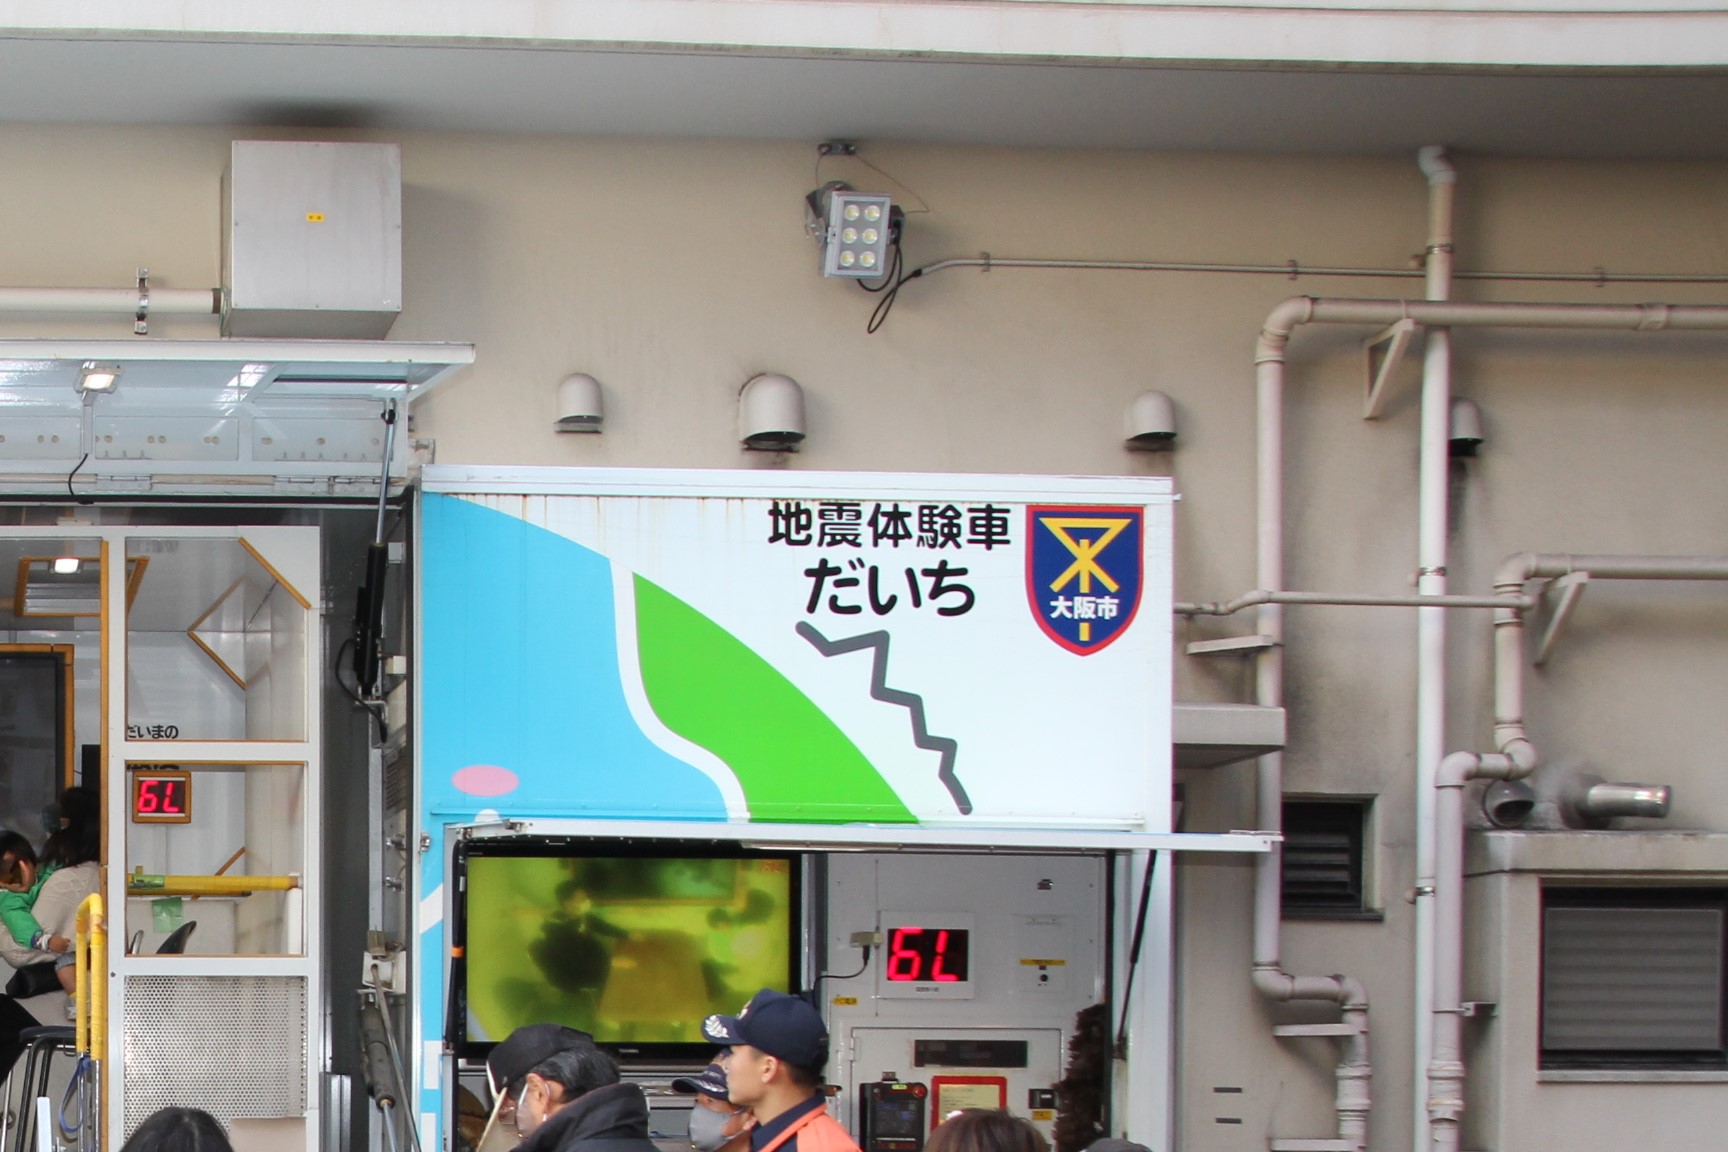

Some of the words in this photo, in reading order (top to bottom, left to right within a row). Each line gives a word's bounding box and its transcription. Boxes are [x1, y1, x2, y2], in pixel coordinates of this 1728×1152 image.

[768, 501, 1011, 550] 地震体験車
[804, 559, 976, 617] だいち
[1049, 594, 1119, 621] 大阪市
